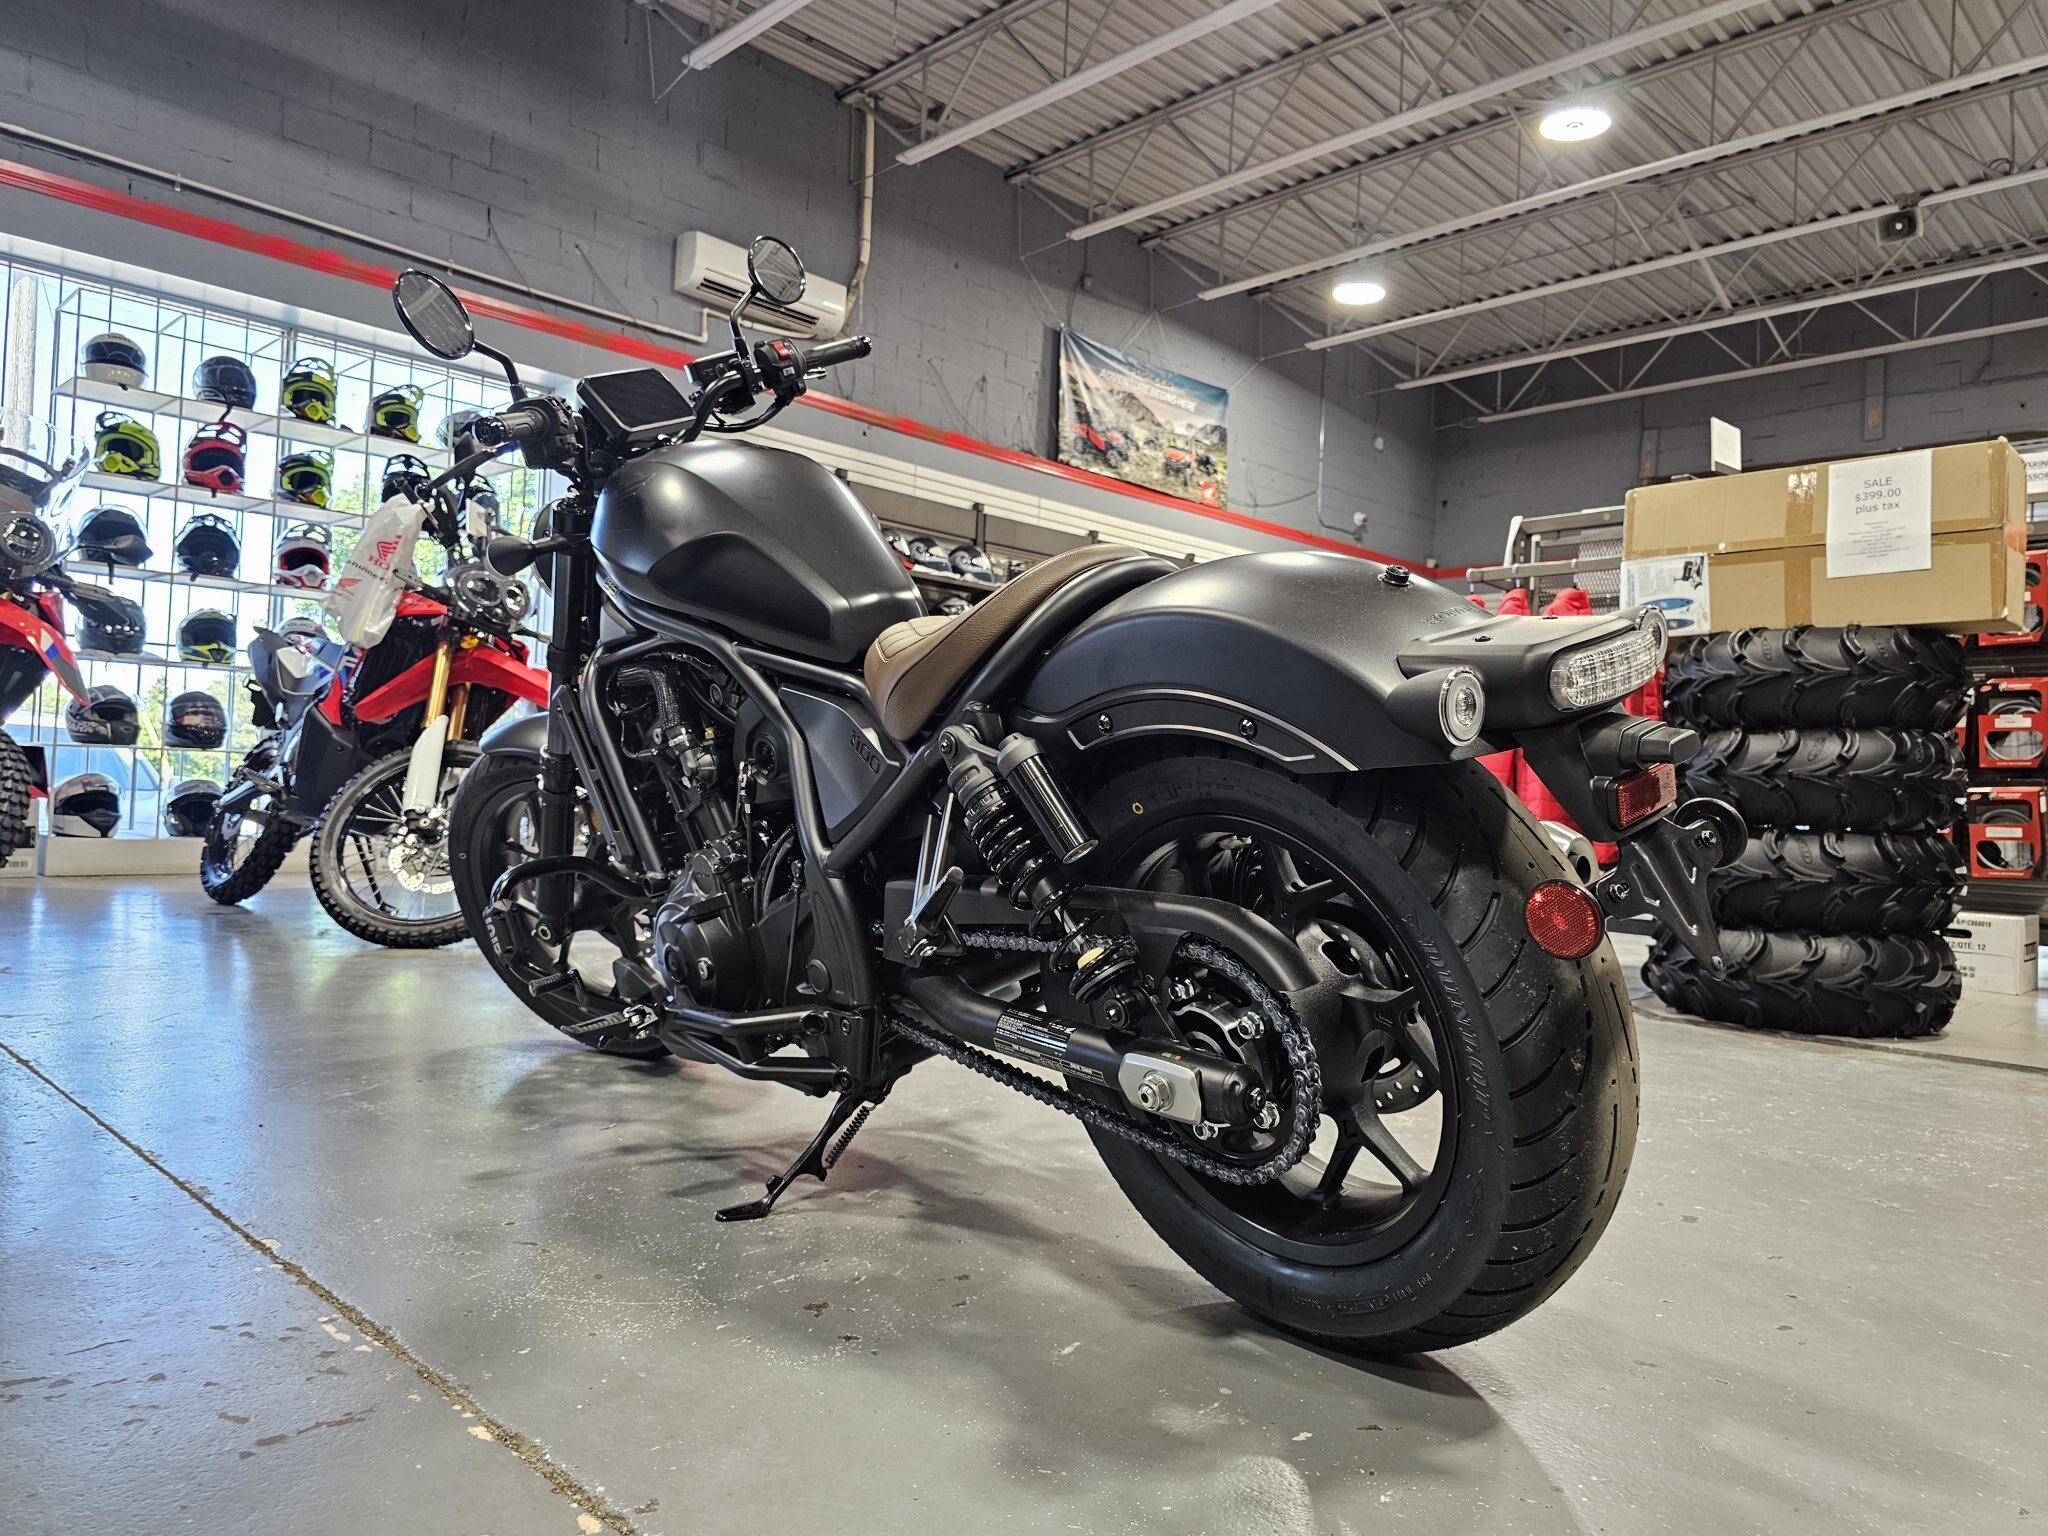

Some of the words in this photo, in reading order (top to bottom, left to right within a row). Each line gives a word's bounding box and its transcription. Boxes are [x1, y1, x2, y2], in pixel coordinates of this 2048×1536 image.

[1863, 476, 1893, 489] SALE
[1854, 487, 1902, 502] $399.00
[1855, 504, 1879, 515] plus
[1882, 501, 1901, 511] tax
